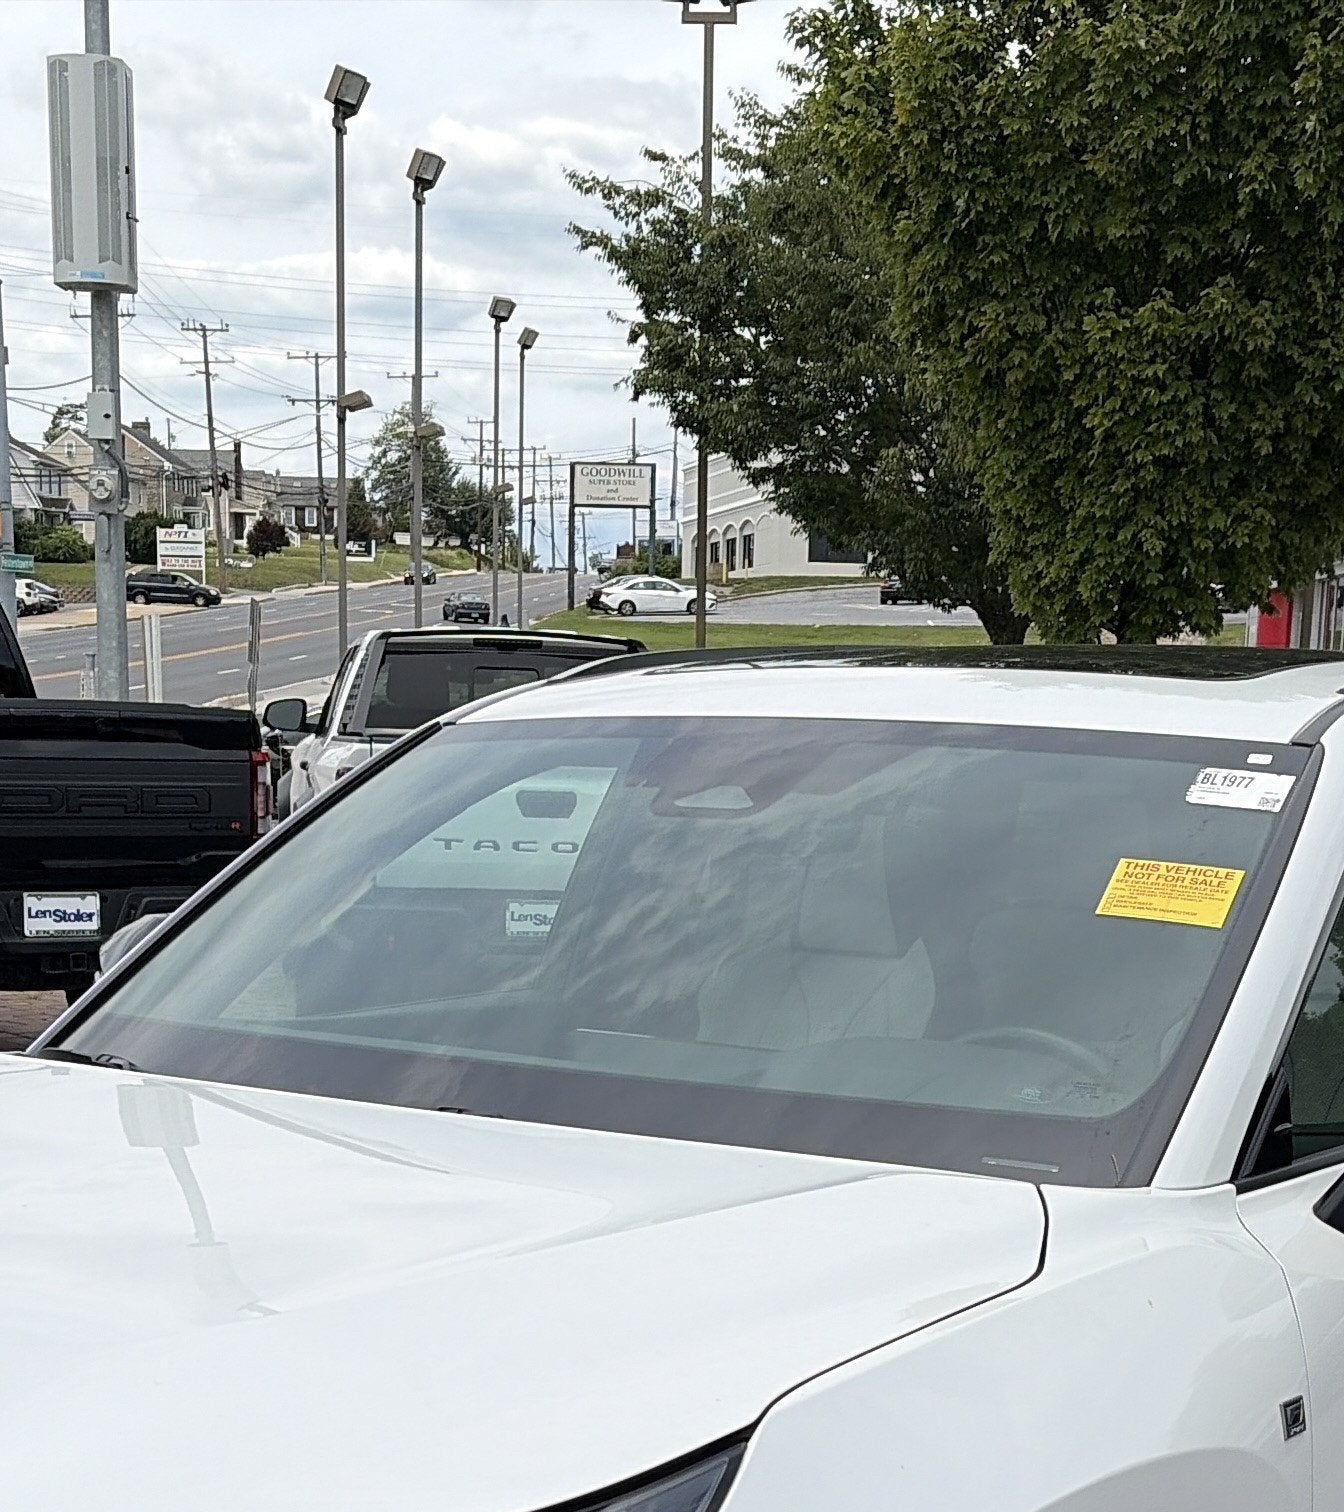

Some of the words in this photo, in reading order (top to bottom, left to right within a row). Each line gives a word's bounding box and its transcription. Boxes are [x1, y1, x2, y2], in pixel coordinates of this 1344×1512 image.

[580, 466, 645, 478] GOODWILL
[1200, 773, 1256, 788] BL1977
[432, 837, 580, 854] TACO
[1124, 861, 1162, 873] THIS
[1165, 864, 1236, 881] VEHICLE
[1123, 870, 1155, 881] NOT
[1155, 874, 1186, 884] FOR
[1188, 877, 1228, 889] SALE
[1130, 879, 1161, 887] DEALER
[1178, 884, 1209, 892] RESALE
